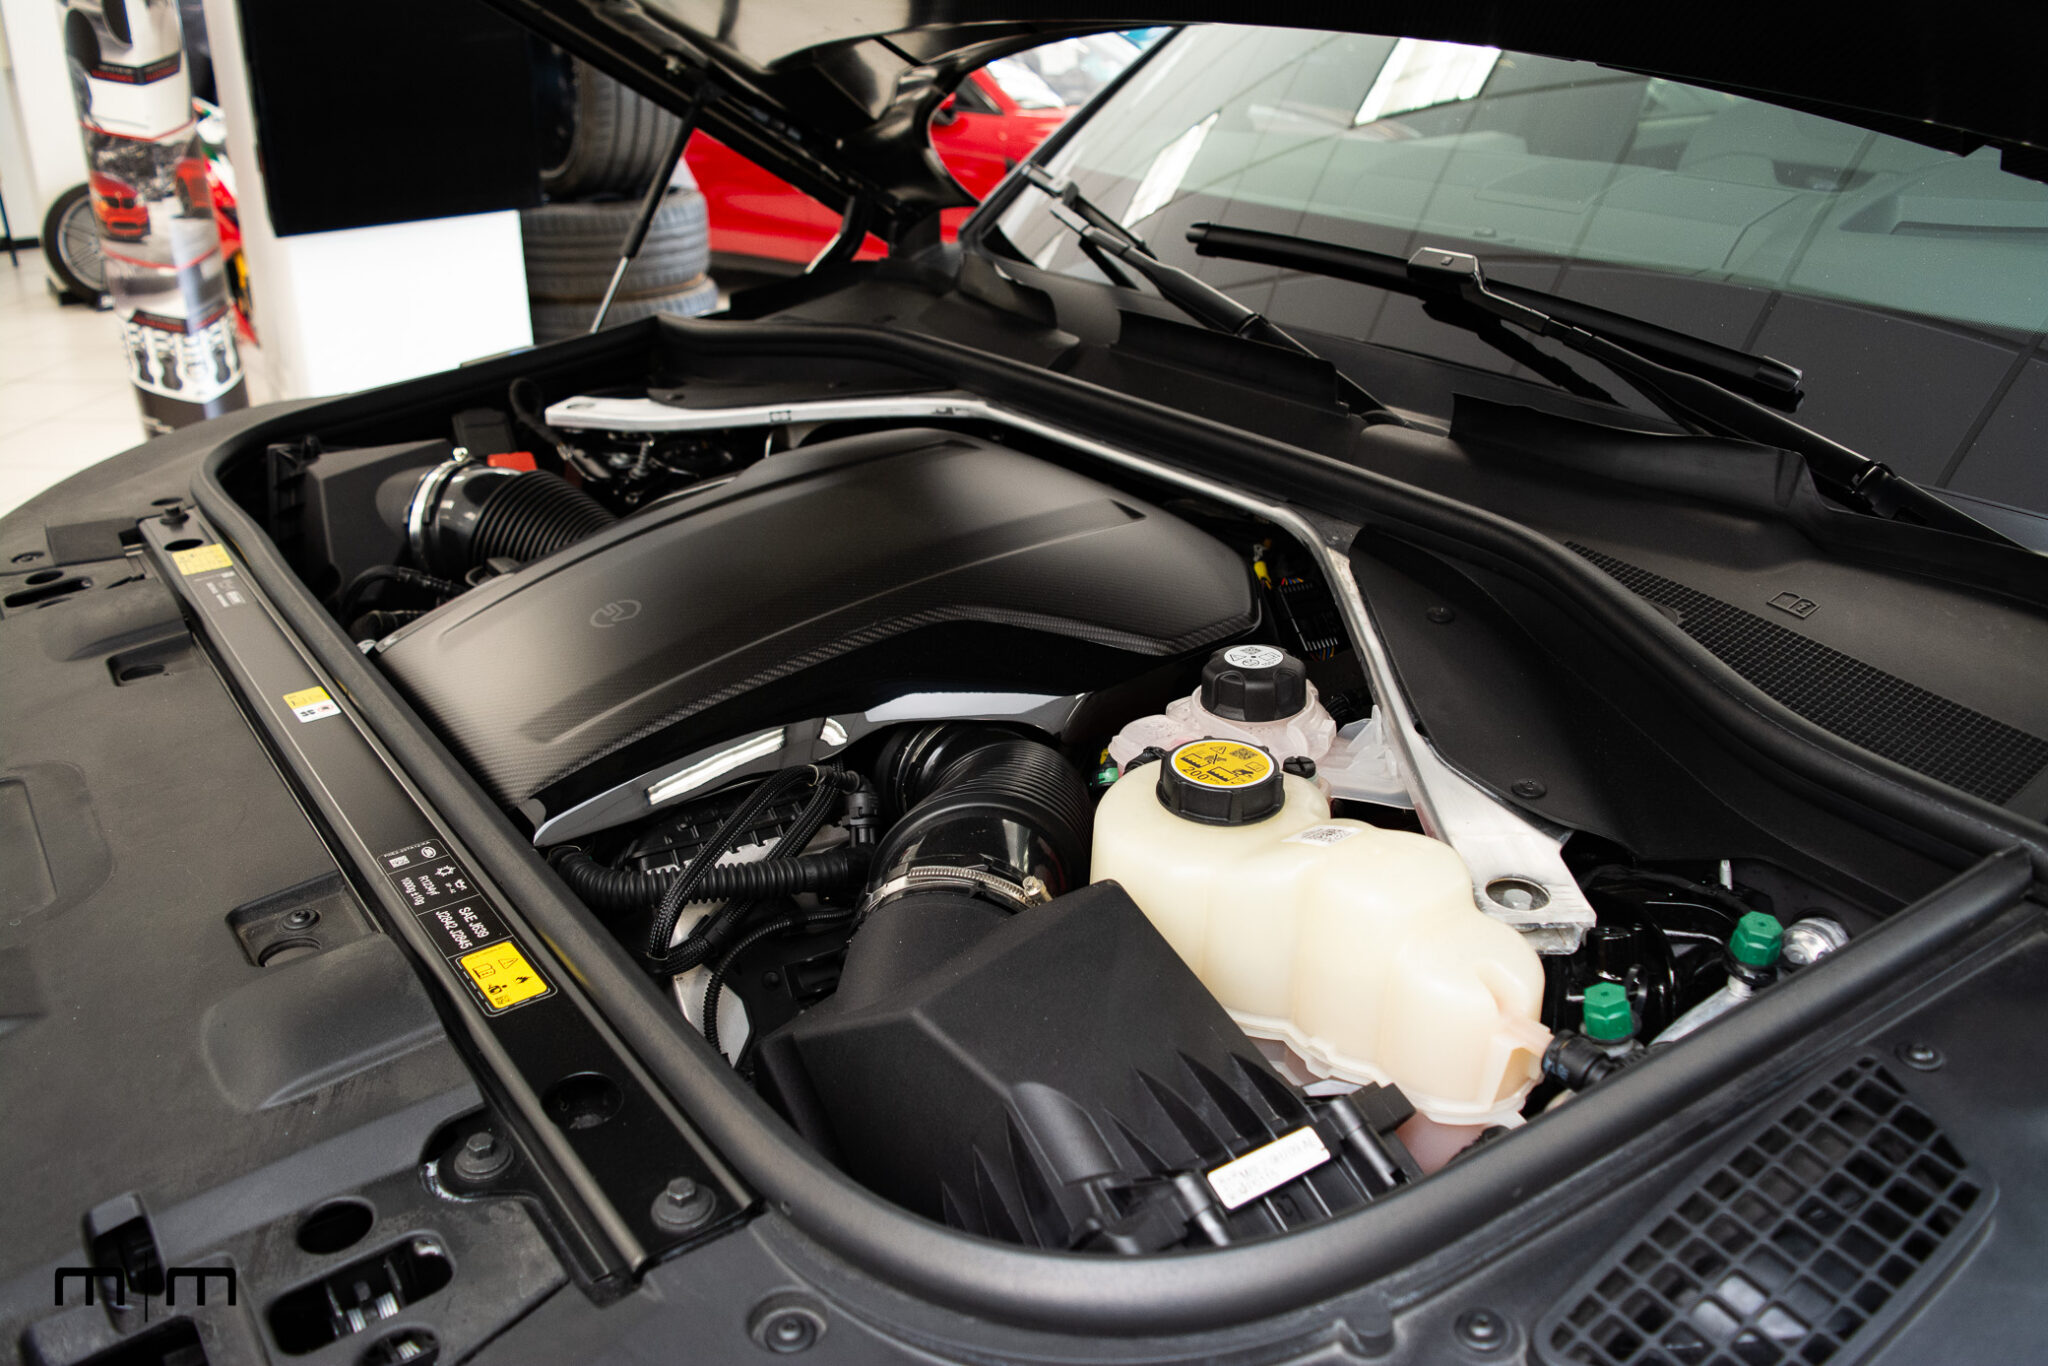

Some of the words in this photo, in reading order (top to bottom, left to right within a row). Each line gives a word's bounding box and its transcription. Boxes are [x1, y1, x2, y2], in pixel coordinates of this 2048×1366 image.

[1181, 766, 1209, 780] 200
[435, 910, 458, 931] J2842
[449, 930, 473, 950] J2845
[458, 906, 478, 923] SAE
[469, 921, 490, 938] J639
